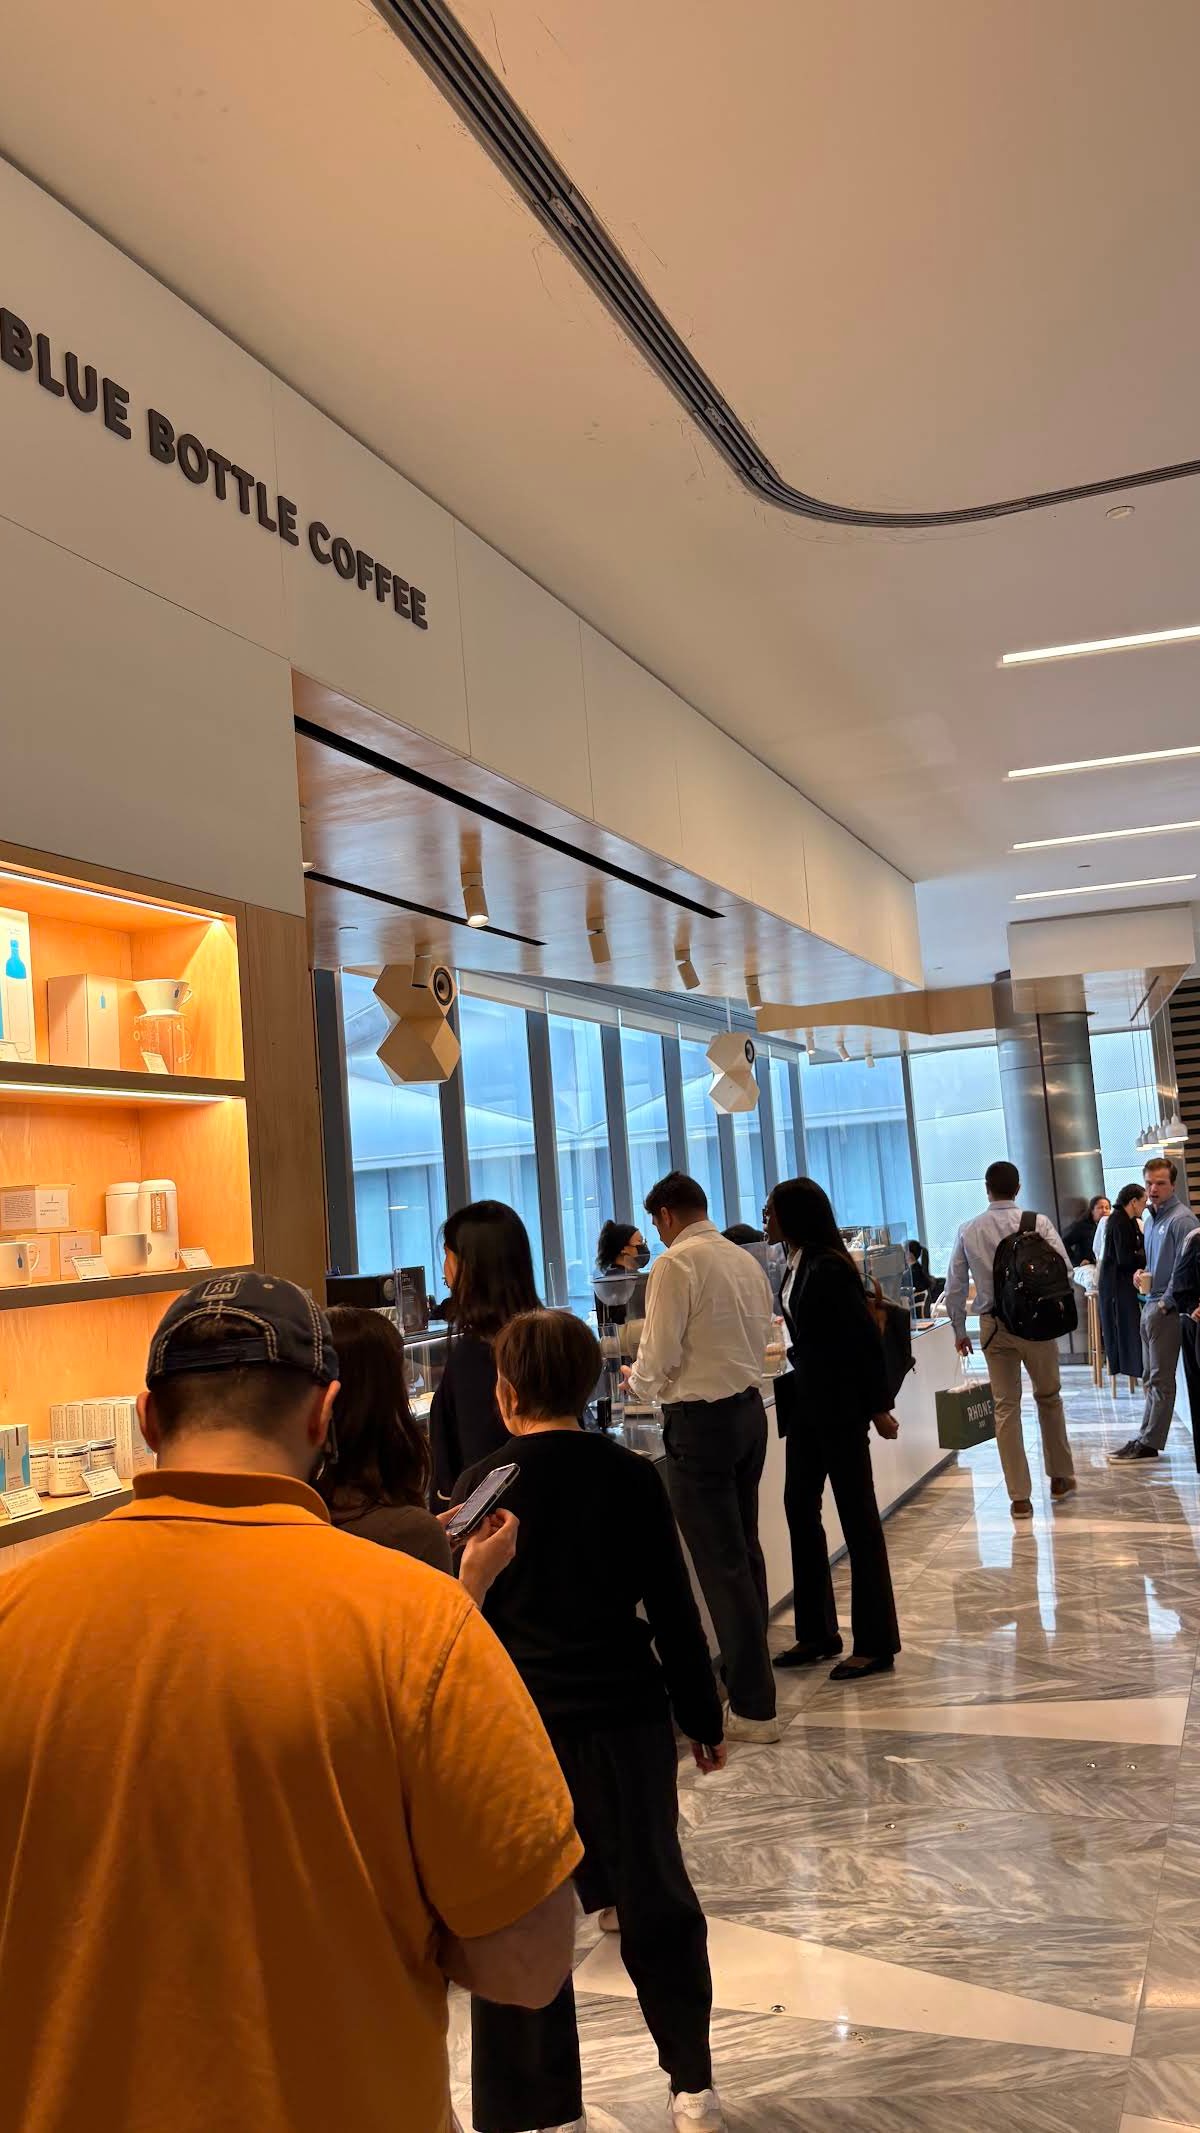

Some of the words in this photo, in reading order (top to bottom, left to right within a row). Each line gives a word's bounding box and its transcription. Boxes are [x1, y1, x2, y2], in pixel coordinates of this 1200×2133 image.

[0, 307, 131, 439] BLUE
[147, 408, 299, 546] BOTTLE
[308, 521, 428, 630] COFFEE
[967, 1399, 993, 1422] RHONE
